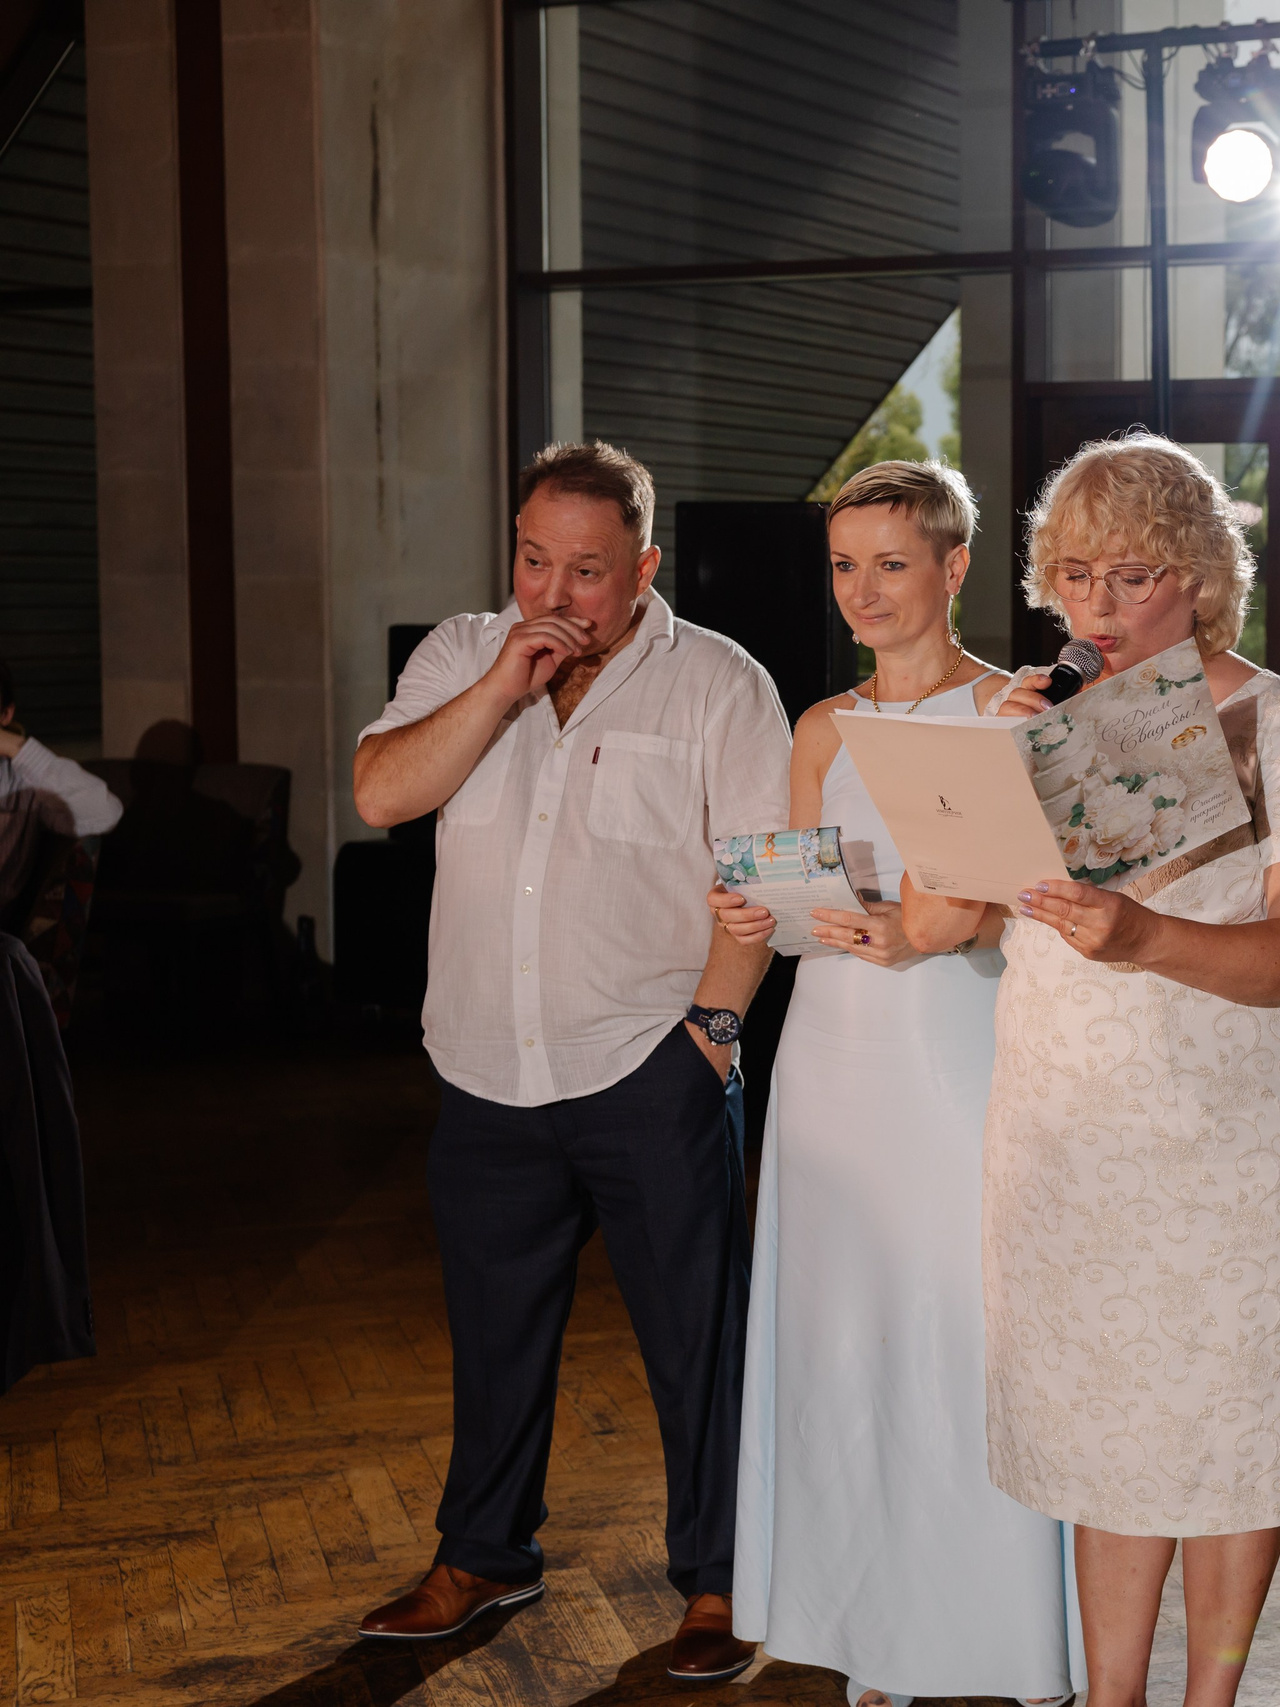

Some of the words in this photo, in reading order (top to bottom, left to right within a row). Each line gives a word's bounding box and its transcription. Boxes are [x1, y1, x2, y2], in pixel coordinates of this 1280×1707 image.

[1098, 717, 1121, 742] С
[1122, 699, 1171, 731] Днем
[1115, 699, 1201, 753] Свадьбы!
[1190, 790, 1227, 812] Счастья
[1203, 805, 1226, 825] паре!
